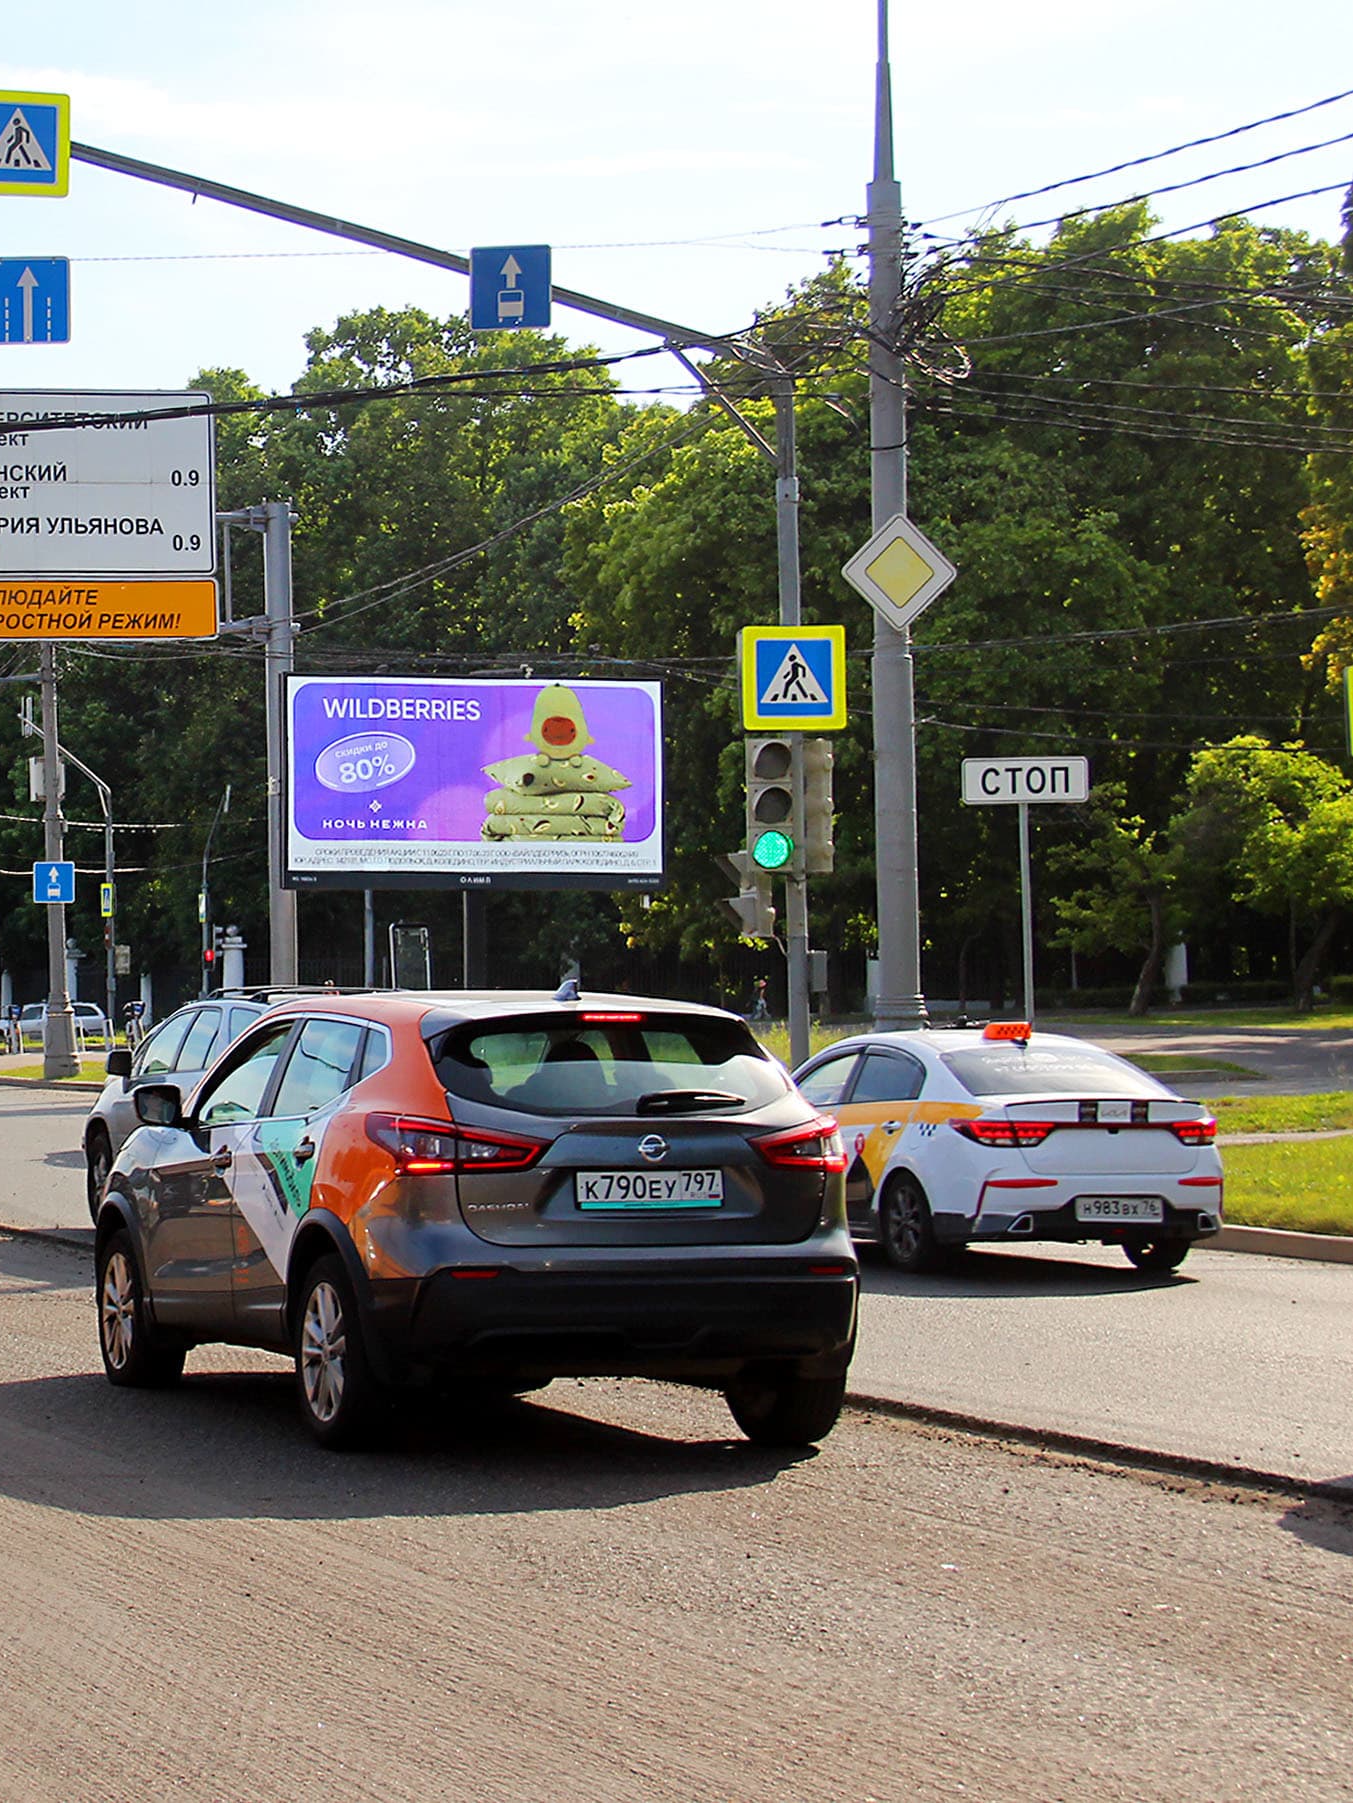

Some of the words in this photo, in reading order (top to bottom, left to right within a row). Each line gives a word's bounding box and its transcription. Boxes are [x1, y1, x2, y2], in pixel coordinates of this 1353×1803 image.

[170, 470, 200, 487] 0.9
[47, 518, 164, 535] УЛЬЯНОВА
[172, 535, 201, 551] 0.9
[98, 613, 181, 630] РЕЖИМ!
[322, 698, 481, 721] WILDBERRIES
[339, 754, 396, 783] 80%
[981, 766, 1070, 795] СТОП
[322, 819, 366, 829] НОЧЬ
[370, 819, 428, 830] НЕЖНА
[585, 1175, 677, 1199] К790ЕУ
[681, 1172, 716, 1192] 797
